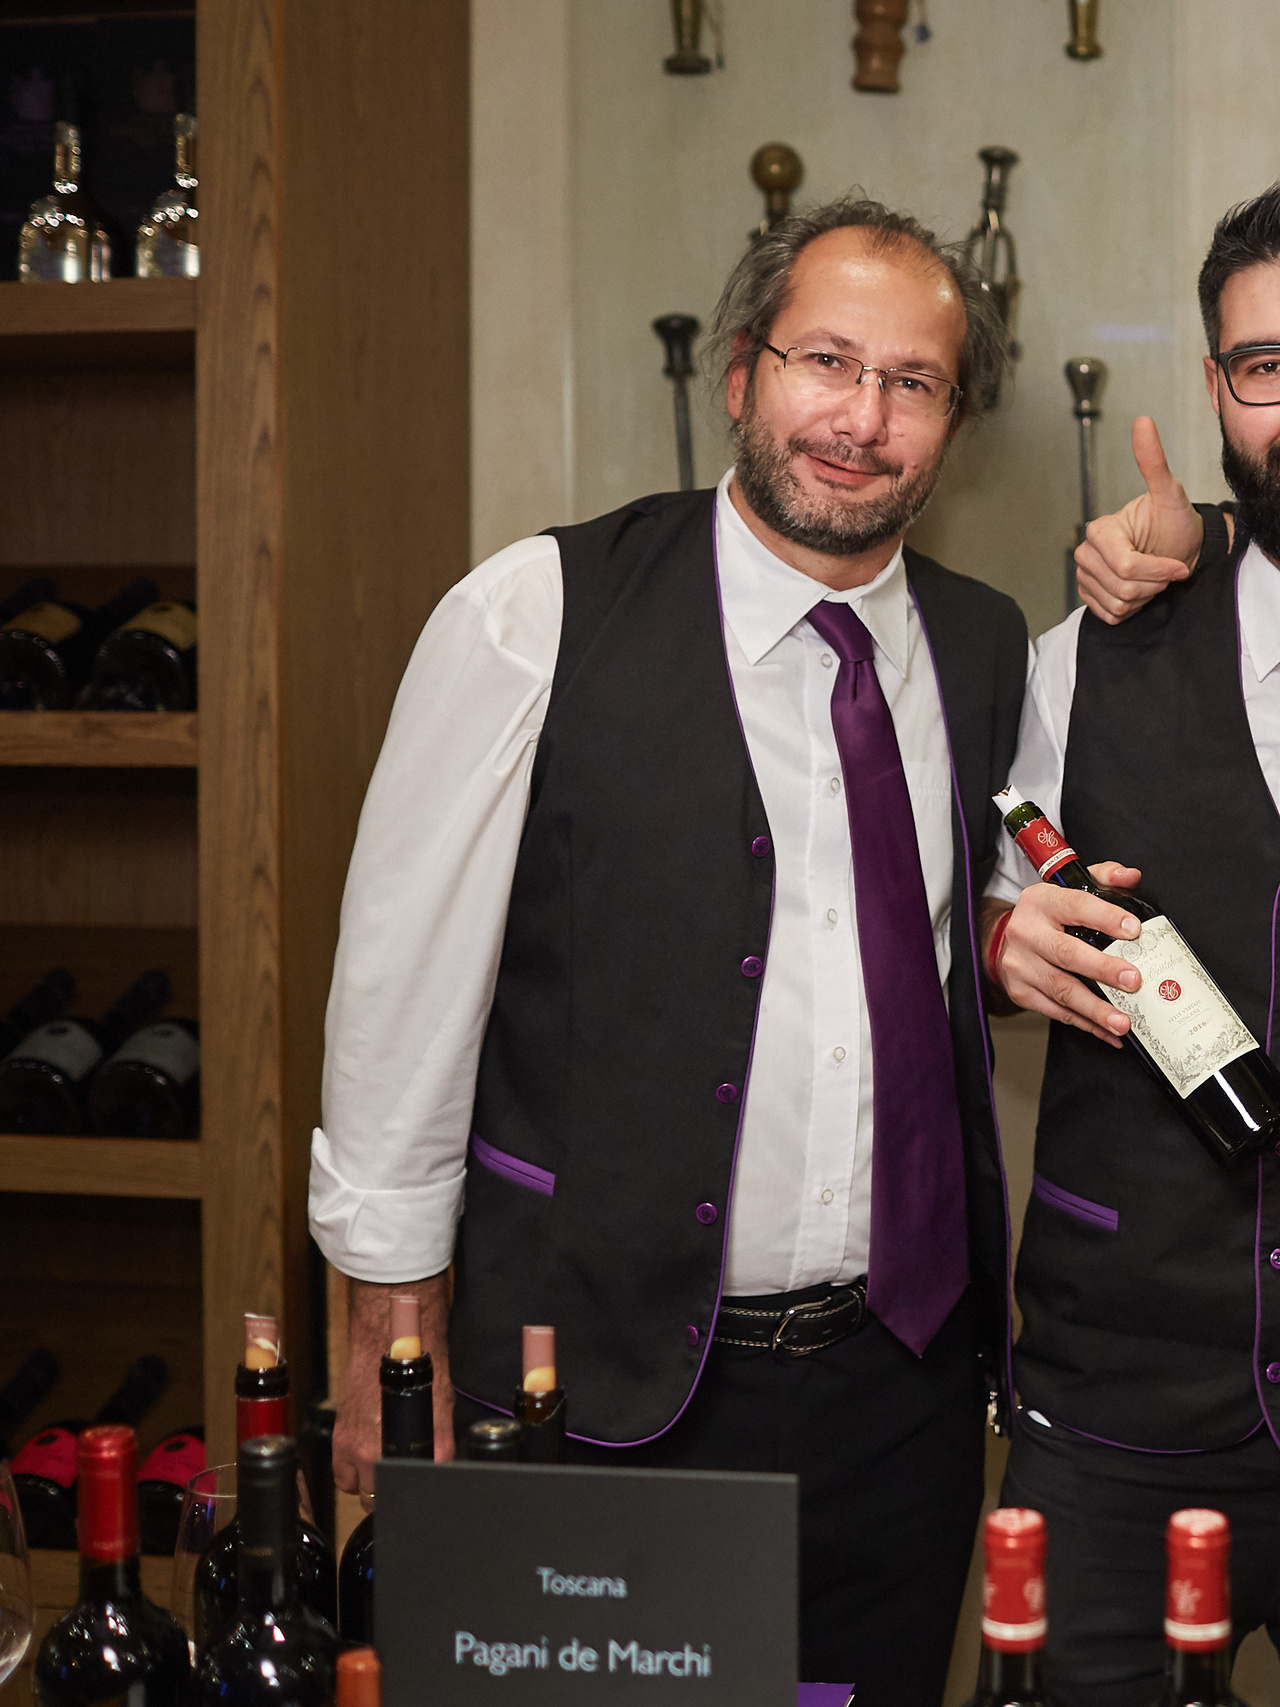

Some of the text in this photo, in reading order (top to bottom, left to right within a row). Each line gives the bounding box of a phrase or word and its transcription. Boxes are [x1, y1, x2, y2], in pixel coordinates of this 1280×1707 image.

[1177, 1006, 1200, 1024] TOSCANA
[1181, 998, 1201, 1014] VERDOT
[1188, 1020, 1207, 1035] 2016
[537, 1566, 627, 1598] Toscana
[455, 1631, 712, 1677] Pagani de Marchi
